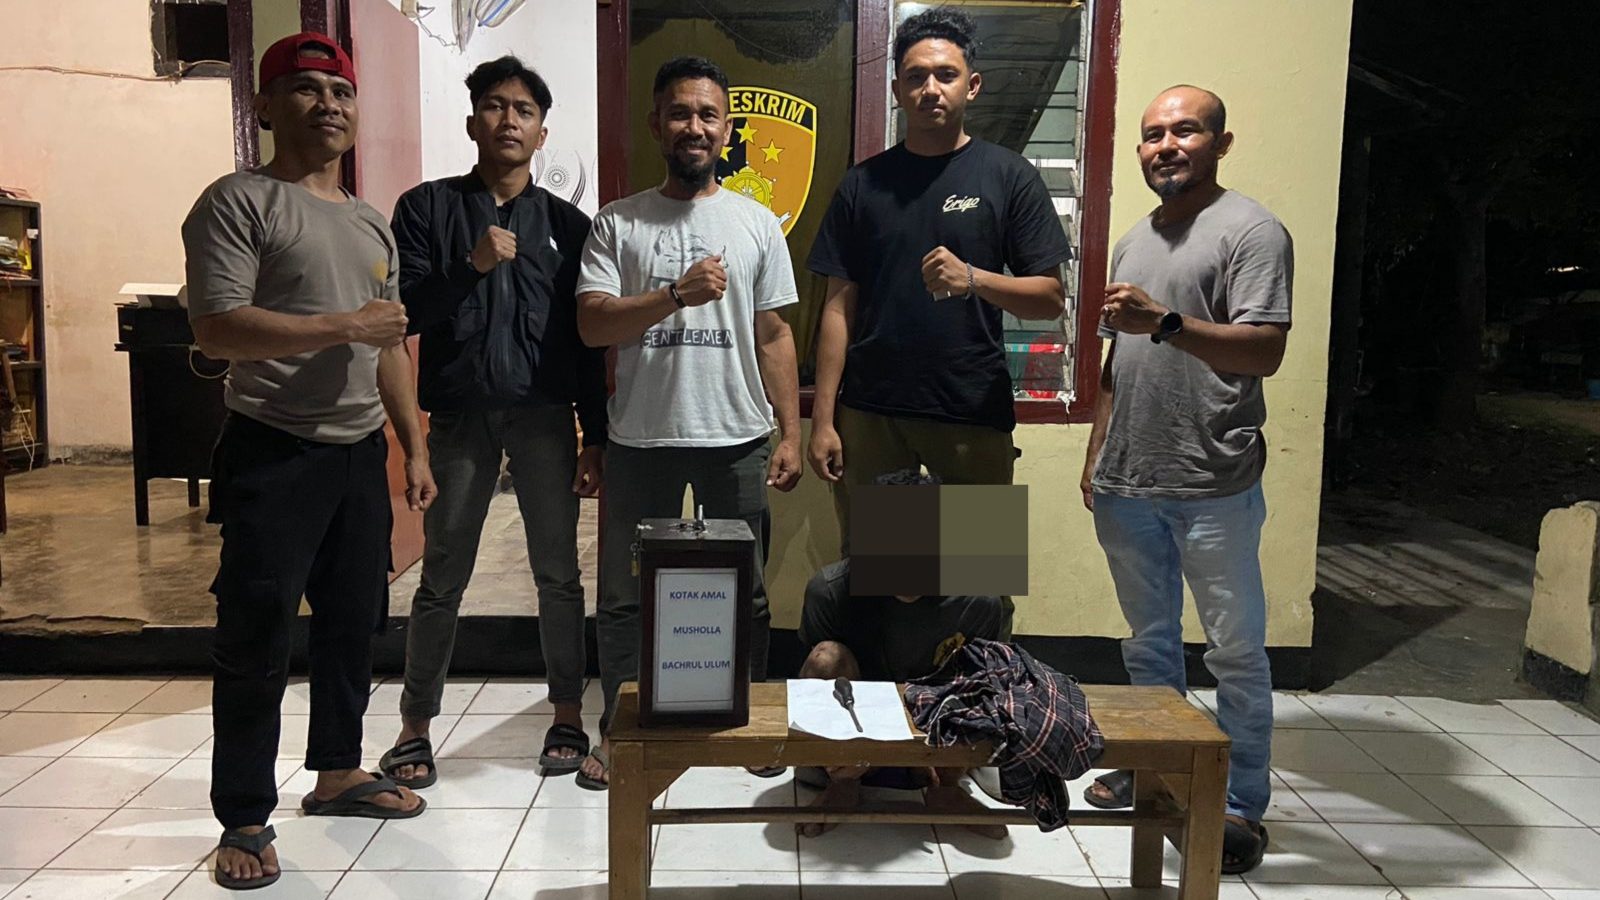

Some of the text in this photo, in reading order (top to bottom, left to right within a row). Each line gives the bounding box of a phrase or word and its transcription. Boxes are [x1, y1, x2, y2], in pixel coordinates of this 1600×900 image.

[729, 92, 806, 123] ESKRIM
[943, 194, 980, 212] Erigo
[642, 330, 734, 349] GENTLEMEN
[669, 591, 727, 600] KOTAK AMAL
[673, 626, 721, 635] MUSHOLLA
[662, 660, 730, 670] BACHRUL ULUM
